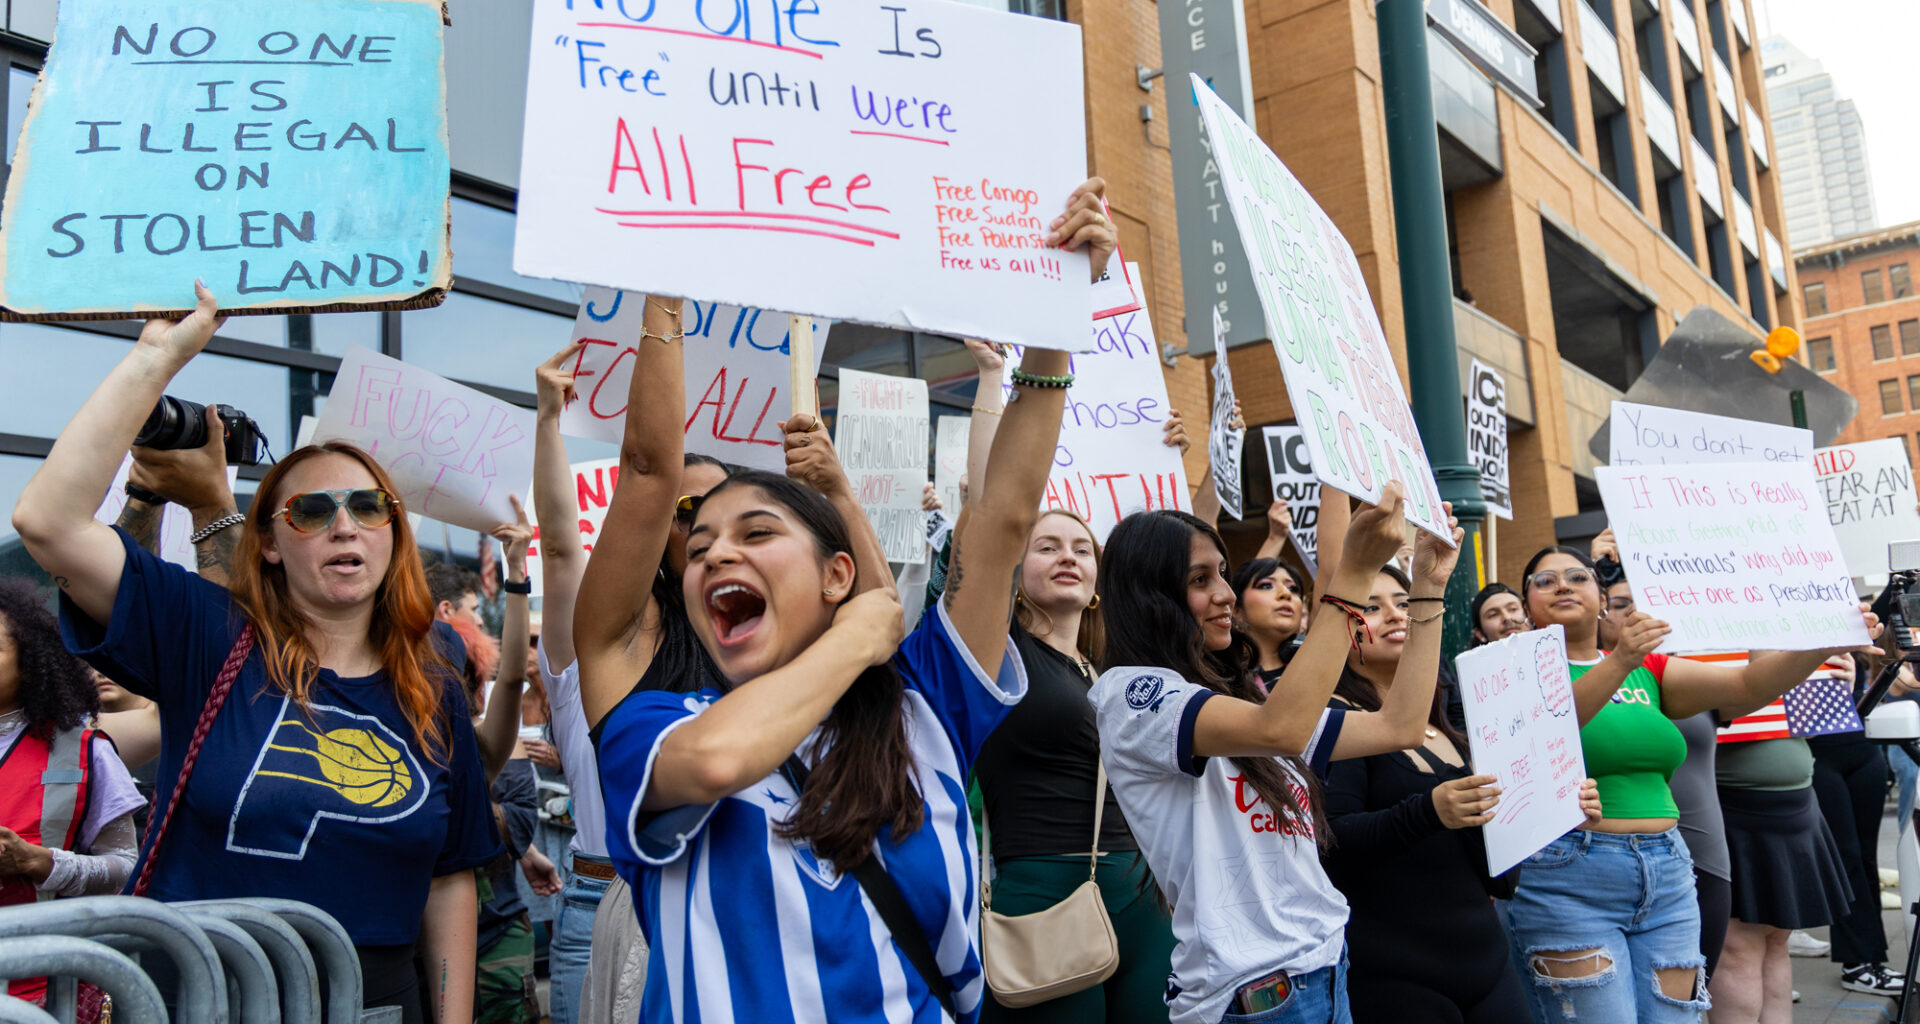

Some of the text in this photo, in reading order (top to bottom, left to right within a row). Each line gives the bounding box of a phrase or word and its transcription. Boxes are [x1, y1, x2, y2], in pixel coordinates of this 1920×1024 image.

[112, 23, 396, 62] NO ONE
[878, 6, 942, 58] Is
[195, 80, 288, 112] IS
[709, 68, 820, 111] until
[75, 118, 425, 154] ILLEGAL
[195, 162, 270, 191] ON
[607, 117, 890, 213] All Free
[1213, 102, 1329, 264] NADIE
[933, 176, 1038, 215] Free Congo
[47, 211, 317, 258] STOLEN
[935, 205, 1042, 231] Free Sudan
[937, 226, 1076, 252] Free Palenst
[236, 250, 428, 294] LAND!
[941, 251, 974, 270] Free
[980, 258, 1001, 271] us
[1243, 195, 1361, 351] ILEGAL
[1258, 270, 1354, 401] UNA
[350, 365, 525, 478] FUCK
[684, 366, 783, 447] ALL
[1470, 408, 1497, 434] OUT
[1622, 408, 1679, 448] You
[1692, 428, 1753, 455] don't
[1268, 434, 1313, 475] IC
[1307, 388, 1448, 537] ROBADA
[859, 475, 894, 504] NOT
[1276, 482, 1317, 501] OUT
[1622, 475, 1808, 511] If This is Really
[1875, 464, 1908, 495] AN
[1871, 494, 1895, 518] AT
[1627, 520, 1680, 545] About
[1788, 514, 1808, 535] of
[1782, 544, 1808, 568] did
[1810, 549, 1834, 571] you
[1643, 585, 1701, 607] Elect
[1705, 586, 1738, 605] one
[1744, 584, 1764, 603] as
[1680, 615, 1711, 641] NO
[1775, 614, 1791, 632] is
[1473, 677, 1488, 704] NO
